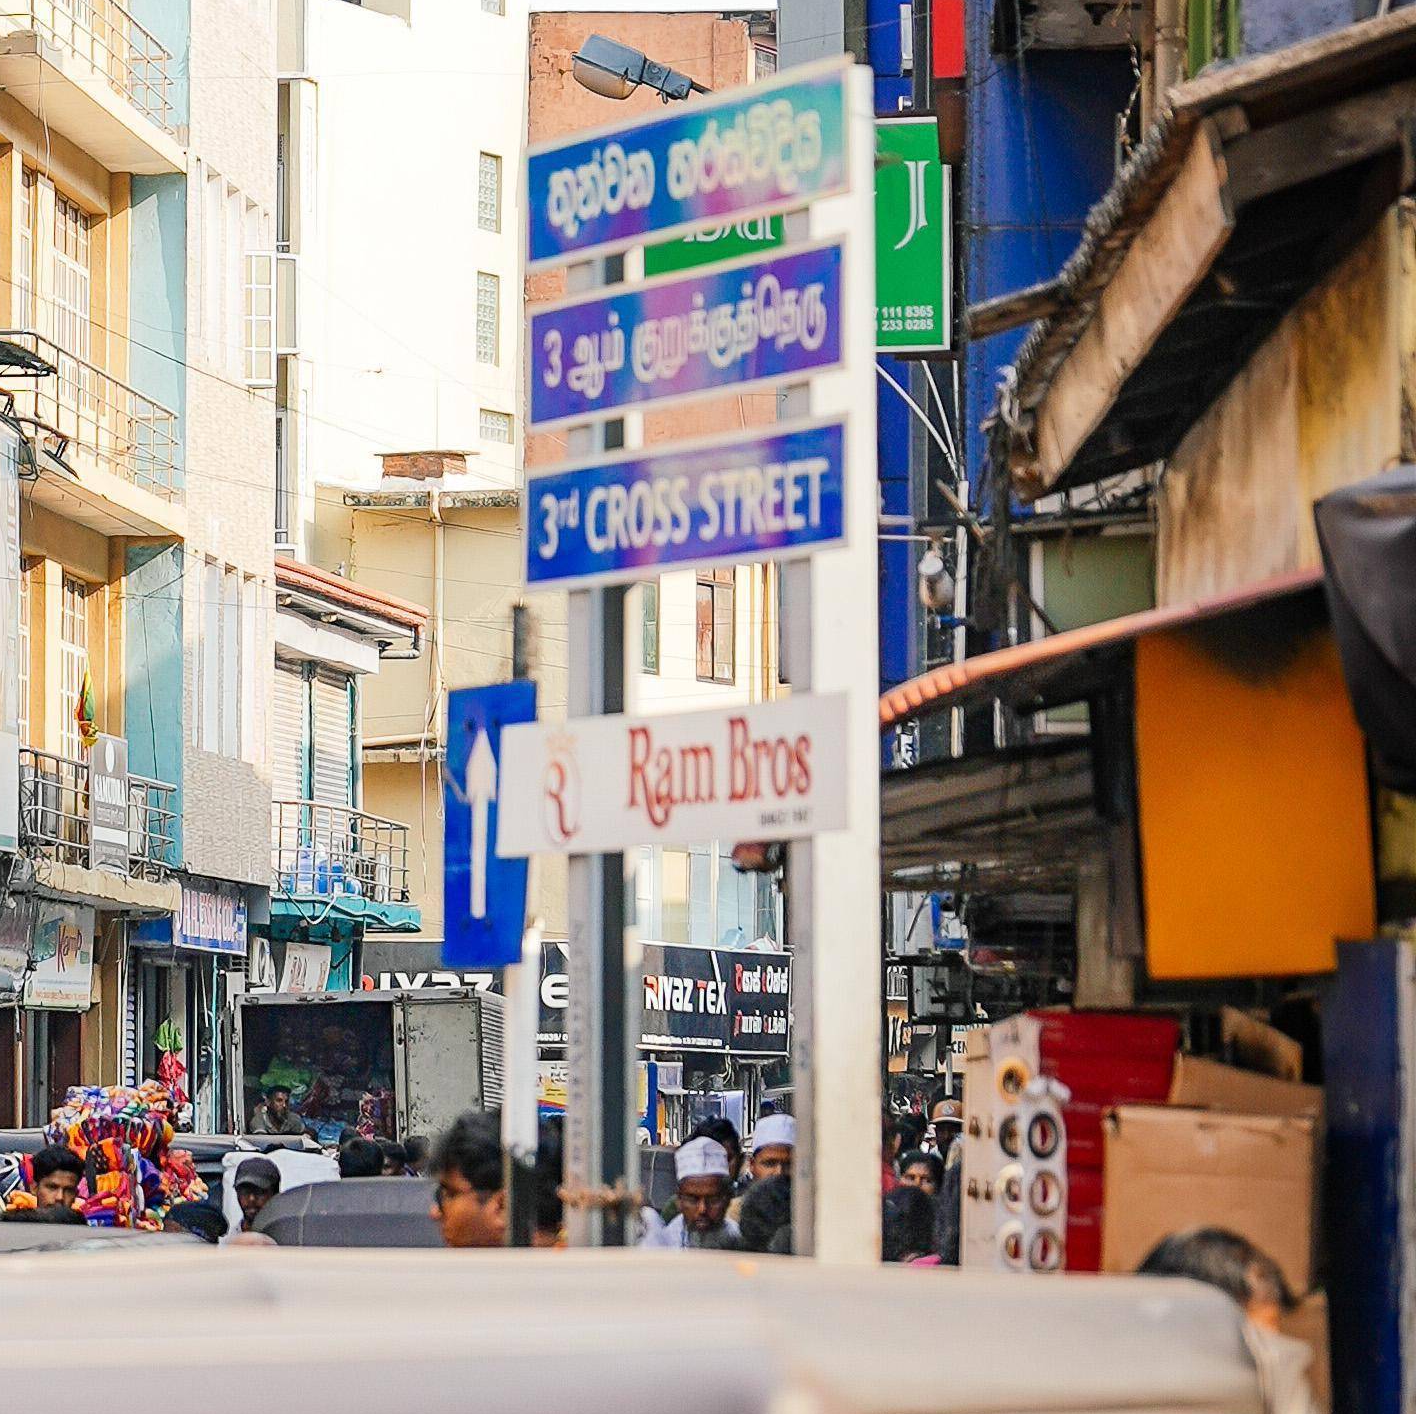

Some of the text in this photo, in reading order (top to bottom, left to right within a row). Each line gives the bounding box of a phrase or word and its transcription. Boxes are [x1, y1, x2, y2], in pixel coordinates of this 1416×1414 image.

[543, 329, 563, 389] 3
[538, 456, 830, 553] 3rd CROSS STREET
[627, 715, 812, 829] Ram Bros
